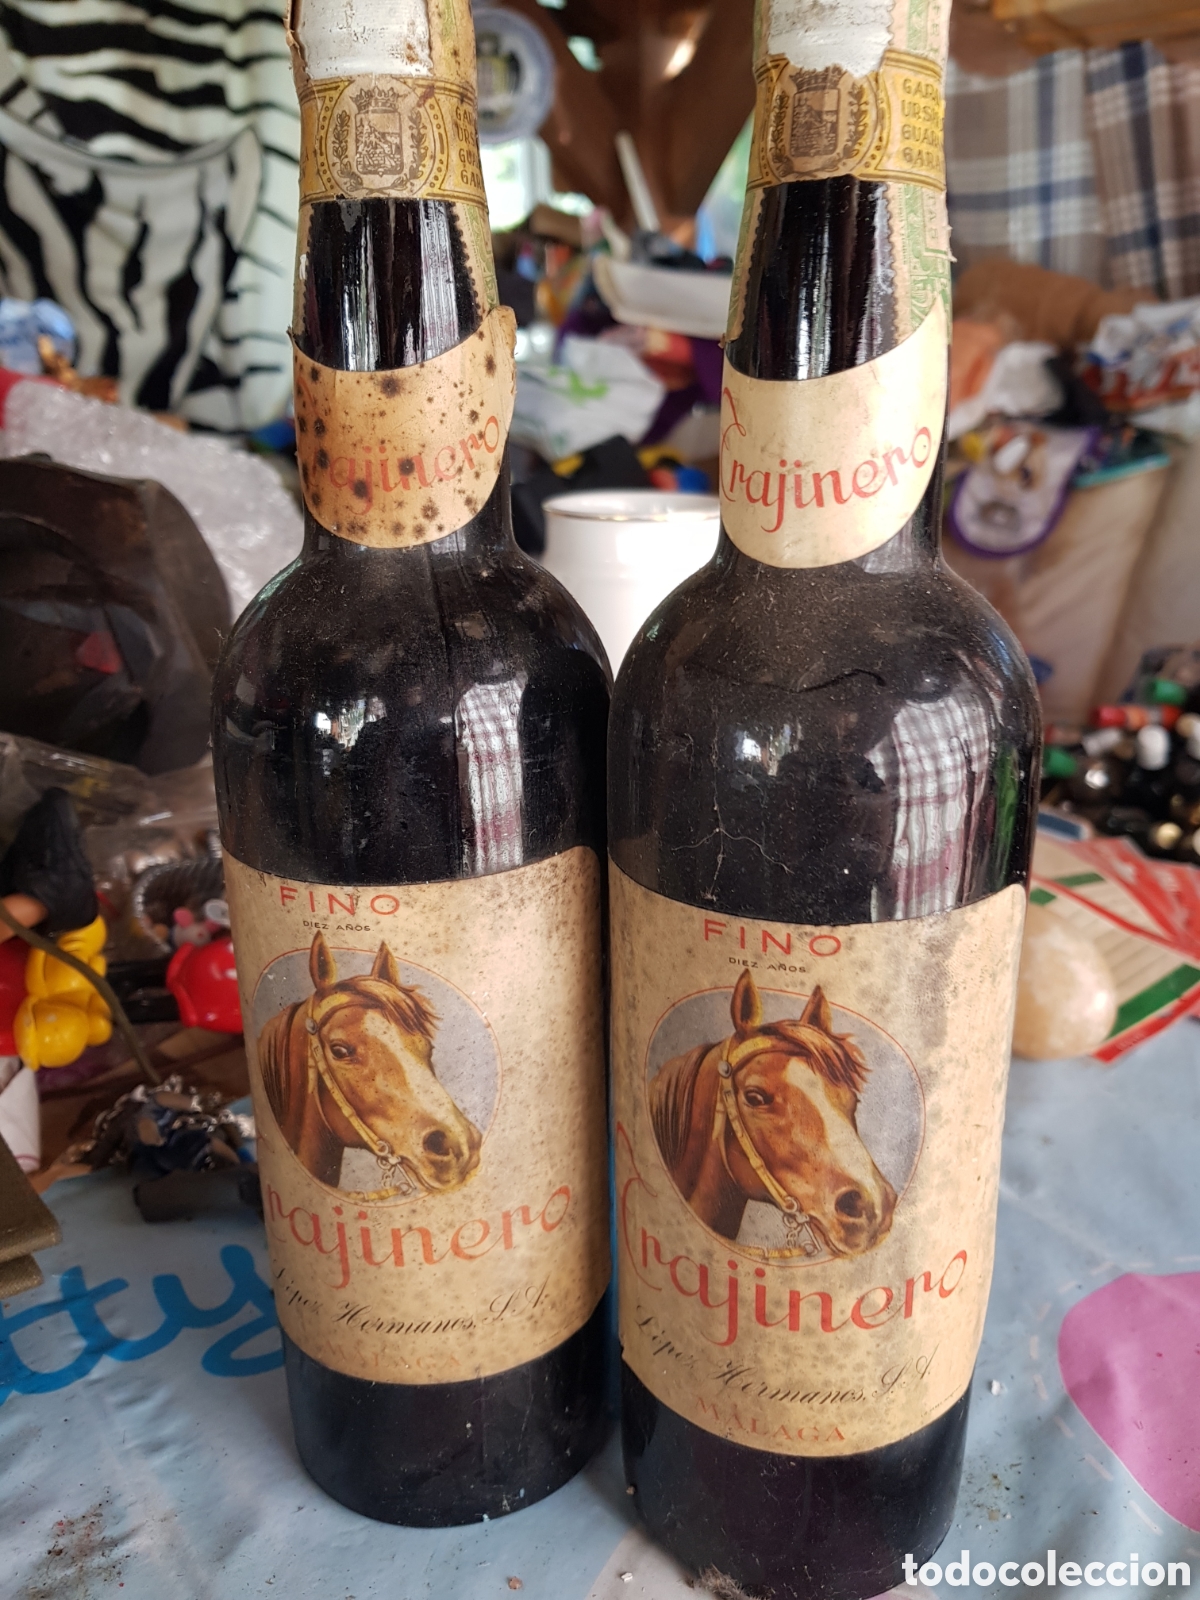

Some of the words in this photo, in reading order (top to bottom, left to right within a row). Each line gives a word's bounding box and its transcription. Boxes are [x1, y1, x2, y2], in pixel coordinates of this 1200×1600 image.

[280, 885, 400, 916] FINO
[303, 920, 329, 930] DIEZ
[704, 918, 842, 957] FINO
[728, 956, 759, 969] DIEZ
[766, 963, 807, 973] AÑOS
[257, 1132, 571, 1290] rajinero
